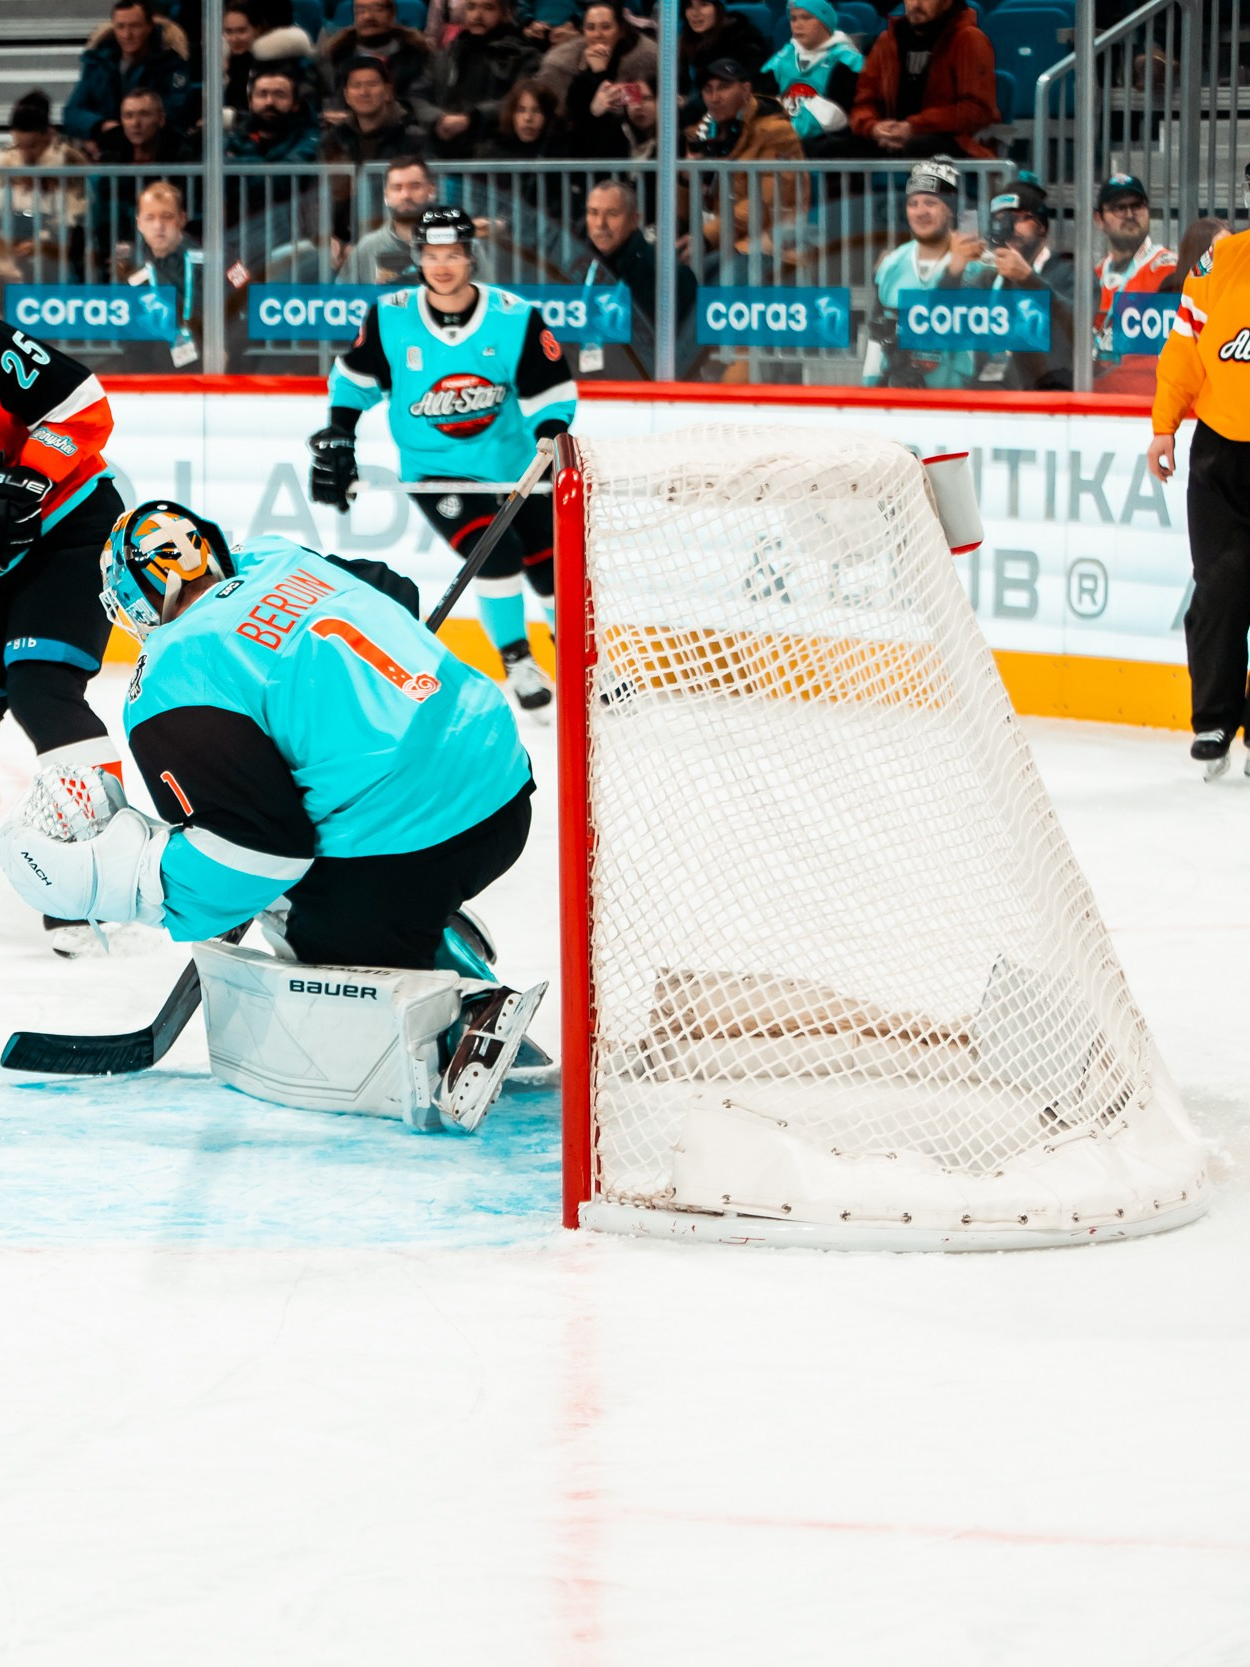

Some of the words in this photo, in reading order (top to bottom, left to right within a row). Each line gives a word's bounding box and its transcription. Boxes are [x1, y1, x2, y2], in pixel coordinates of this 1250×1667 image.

[16, 297, 130, 326] согаз
[259, 298, 369, 328] согаз
[706, 302, 808, 332] согаз
[908, 304, 1010, 336] согаз
[0, 330, 51, 389] 25
[235, 568, 336, 651] BERDIN
[307, 616, 442, 704] 1
[160, 770, 194, 817] 1
[20, 851, 53, 886] MACH
